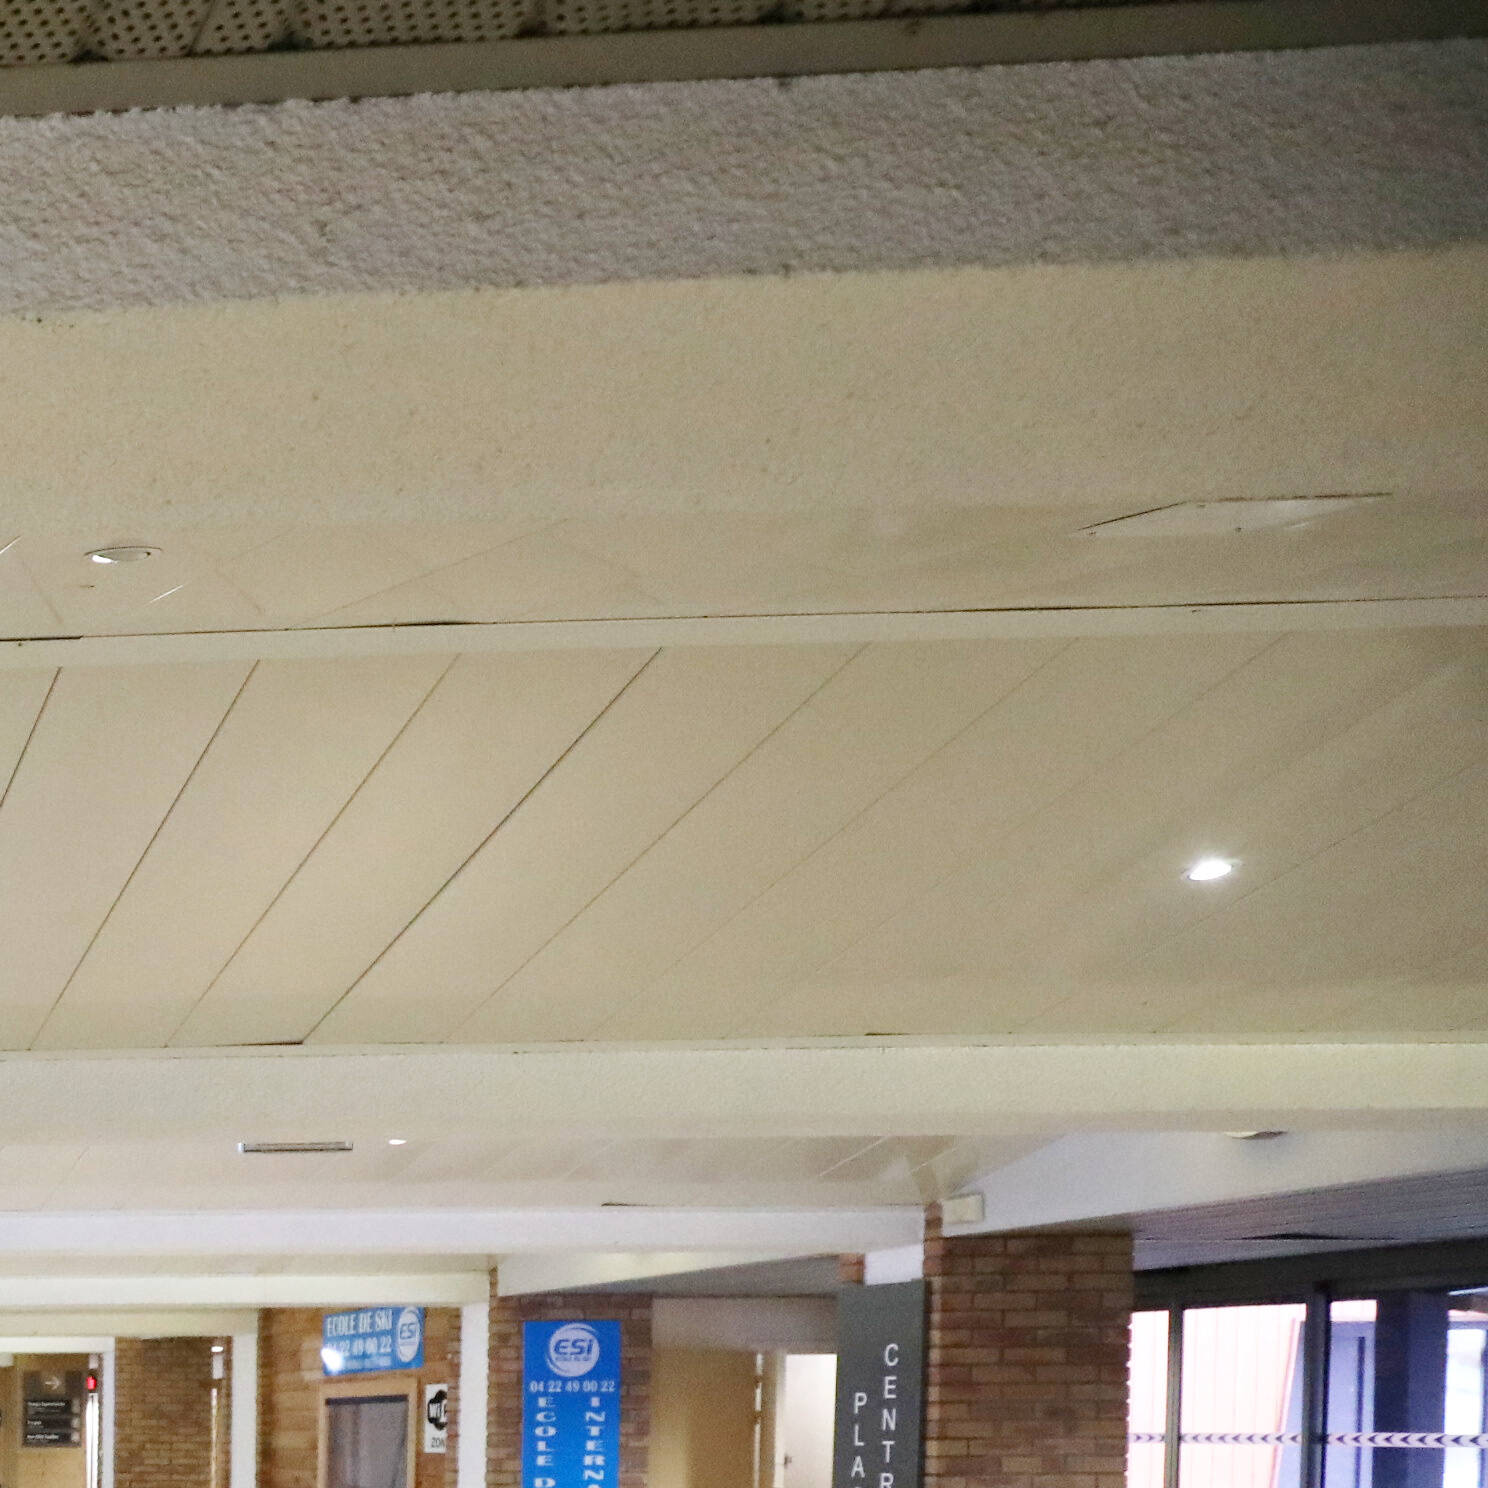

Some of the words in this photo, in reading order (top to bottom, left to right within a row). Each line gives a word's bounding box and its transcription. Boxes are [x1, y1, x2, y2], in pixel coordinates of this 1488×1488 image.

[327, 1313, 356, 1337] ECOLE
[359, 1312, 372, 1333] DE
[375, 1309, 393, 1331] SKI
[529, 1380, 544, 1392] 04
[548, 1380, 562, 1392] 22
[565, 1380, 580, 1392] 49
[583, 1380, 598, 1392] 00
[600, 1380, 615, 1392] 22
[534, 1397, 557, 1467] ECOLE
